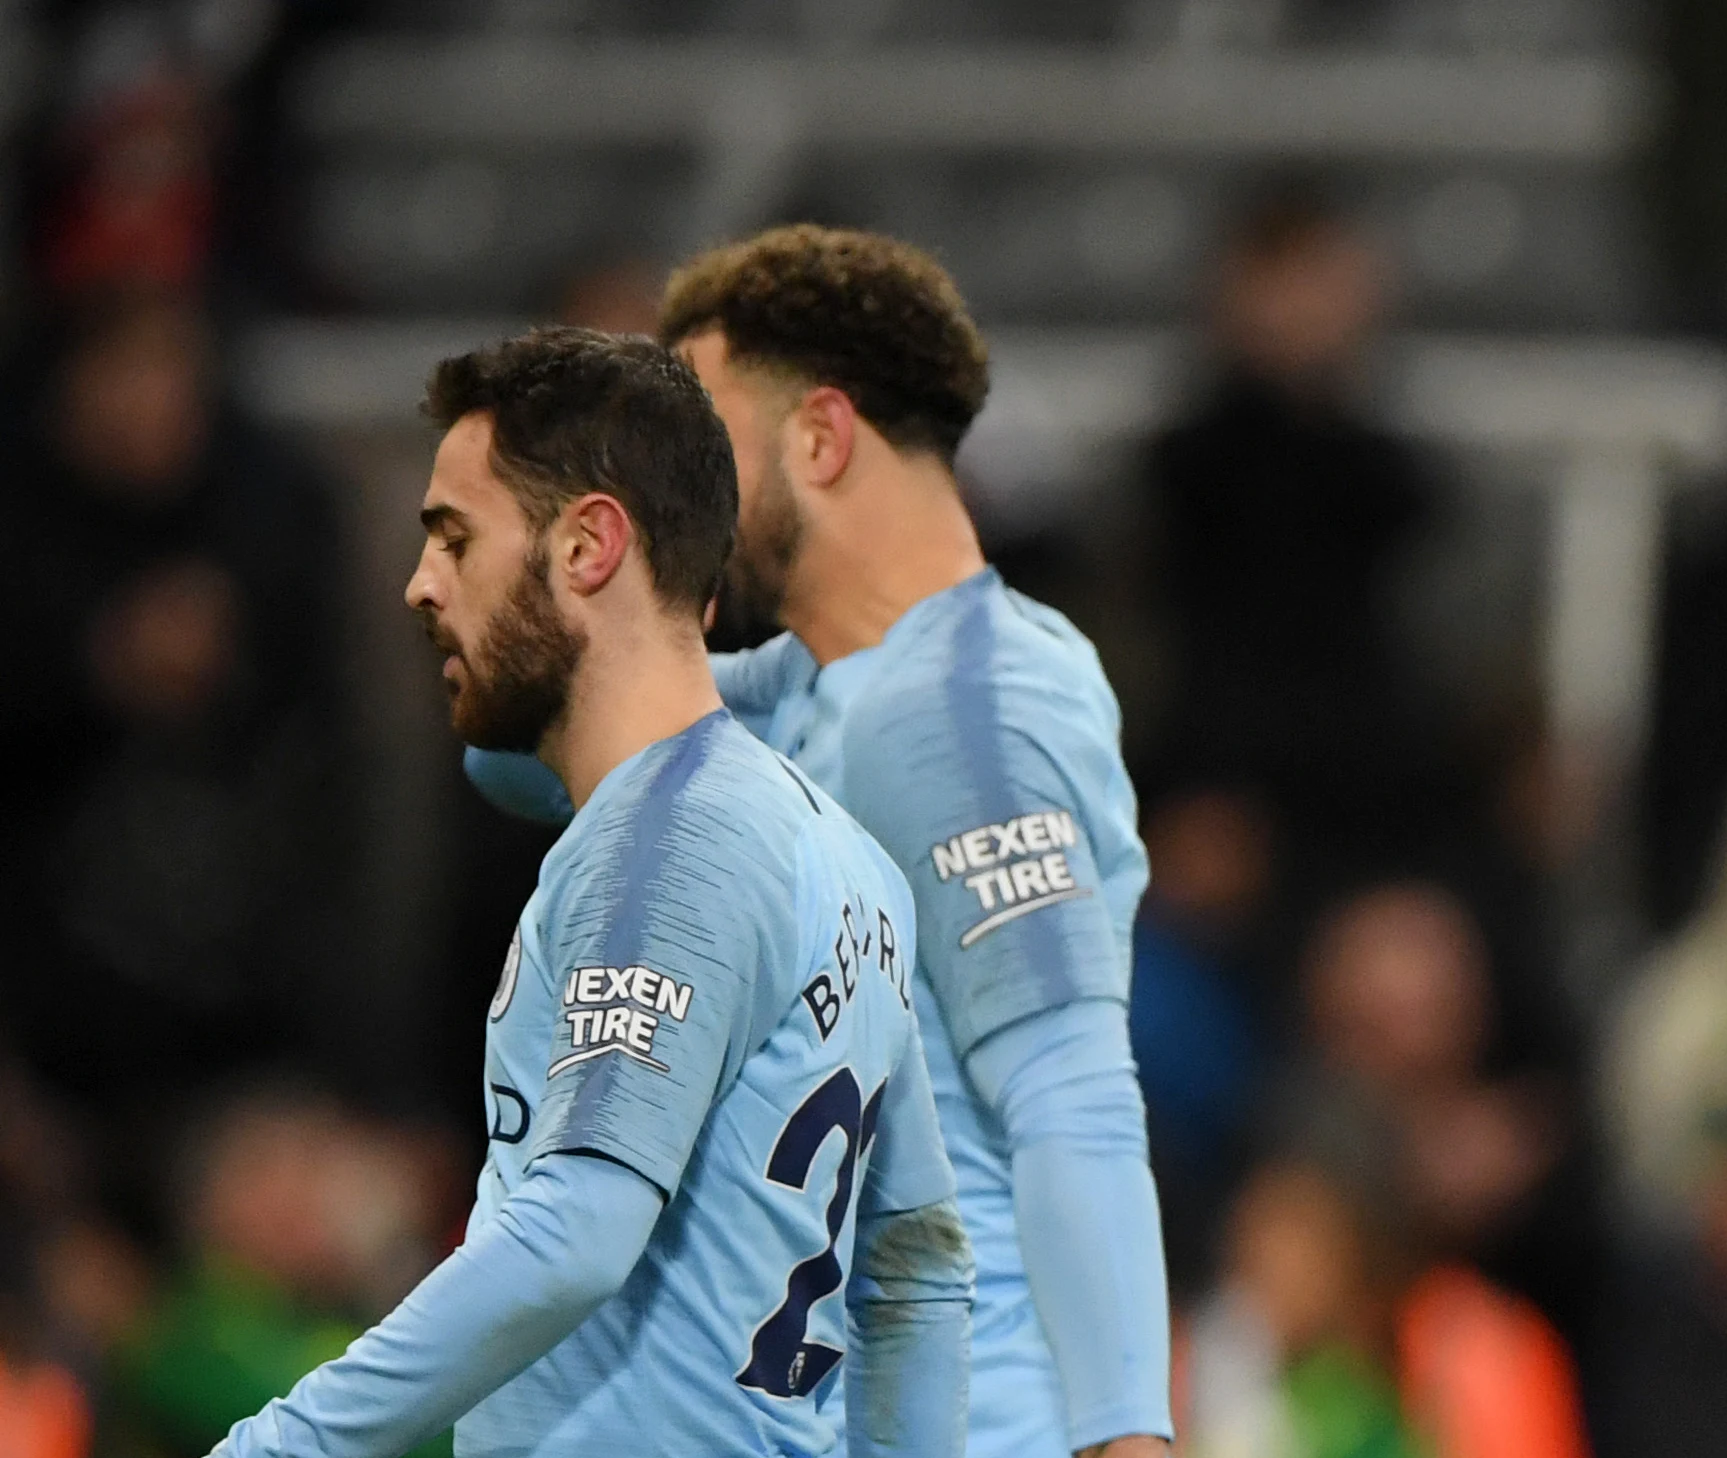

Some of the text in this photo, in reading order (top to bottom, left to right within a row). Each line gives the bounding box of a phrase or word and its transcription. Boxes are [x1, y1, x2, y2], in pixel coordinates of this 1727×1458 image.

[931, 810, 1078, 880] NEXEN
[963, 854, 1075, 911] TIRE
[563, 964, 694, 1022] NEXEN
[565, 1006, 660, 1053] TIRE
